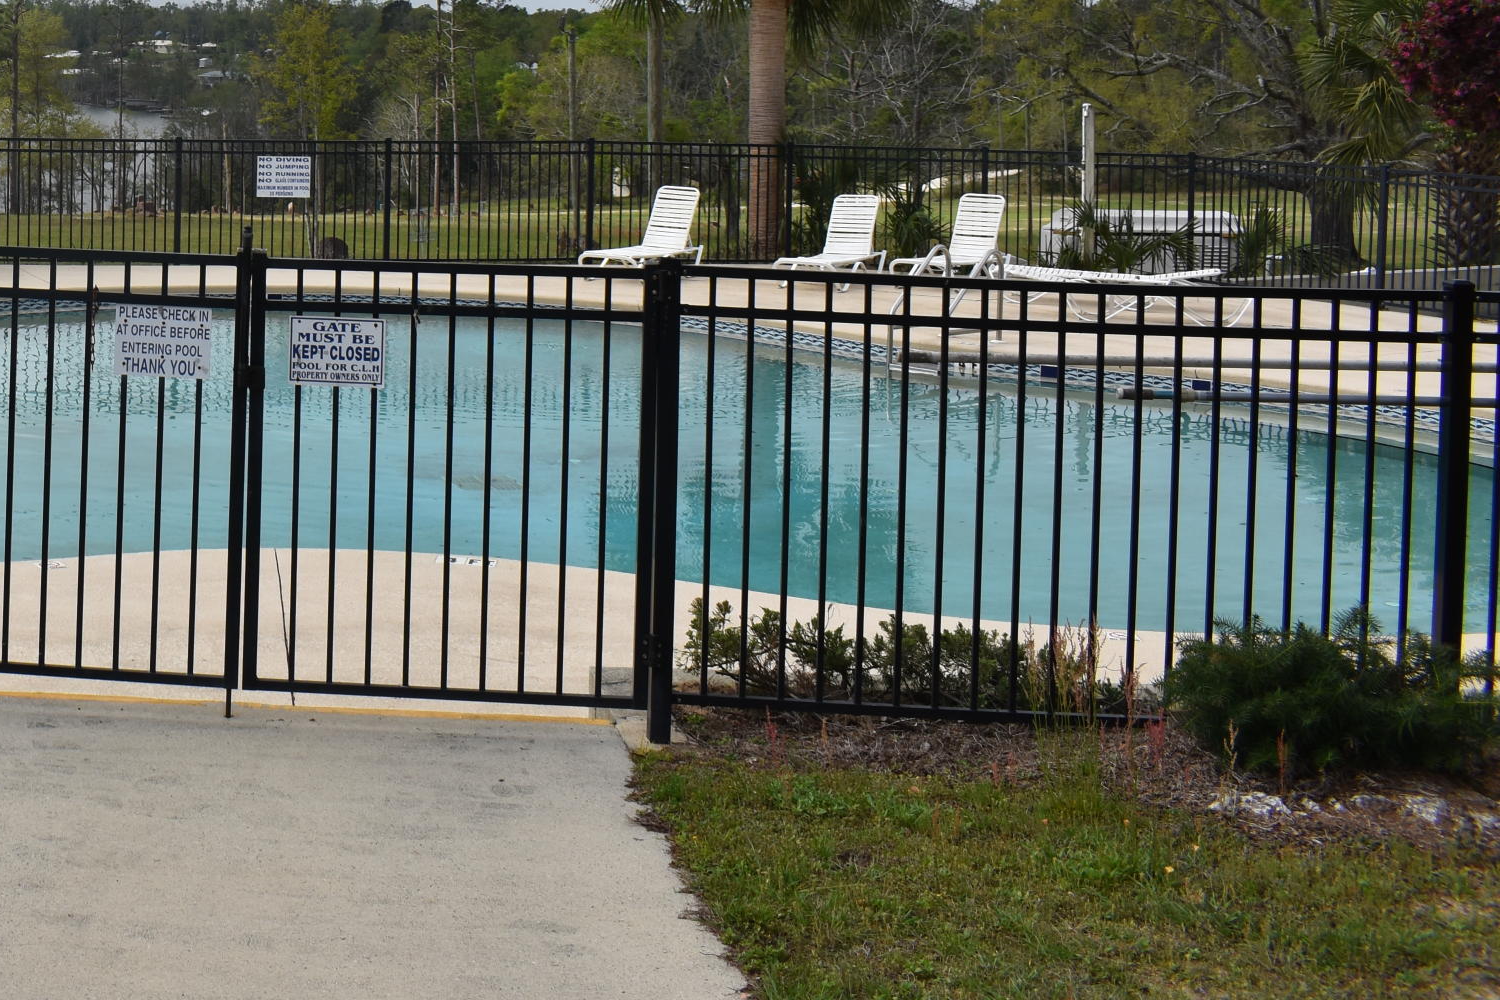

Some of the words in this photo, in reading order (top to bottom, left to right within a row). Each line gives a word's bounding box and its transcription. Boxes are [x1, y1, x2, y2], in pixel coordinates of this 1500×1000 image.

[119, 306, 158, 319] PLEASE
[161, 308, 196, 321] CHECK
[199, 310, 209, 322] IN
[116, 323, 128, 335] AT
[131, 324, 166, 338] OFFICE
[170, 326, 210, 340] BEFORE
[312, 321, 361, 333] GATE
[298, 332, 346, 343] MUST
[352, 334, 375, 345] BE
[121, 341, 172, 355] ENTERING
[175, 344, 203, 357] POOL
[292, 344, 326, 360] KEPT
[329, 345, 380, 362] CLOSED
[124, 357, 166, 374] THANK
[170, 360, 196, 376] YOU
[292, 361, 321, 370] POOL
[325, 363, 347, 371] FOR
[292, 370, 329, 380] PROPERTY
[330, 372, 360, 381] OWNERS
[361, 373, 380, 382] ONLY
